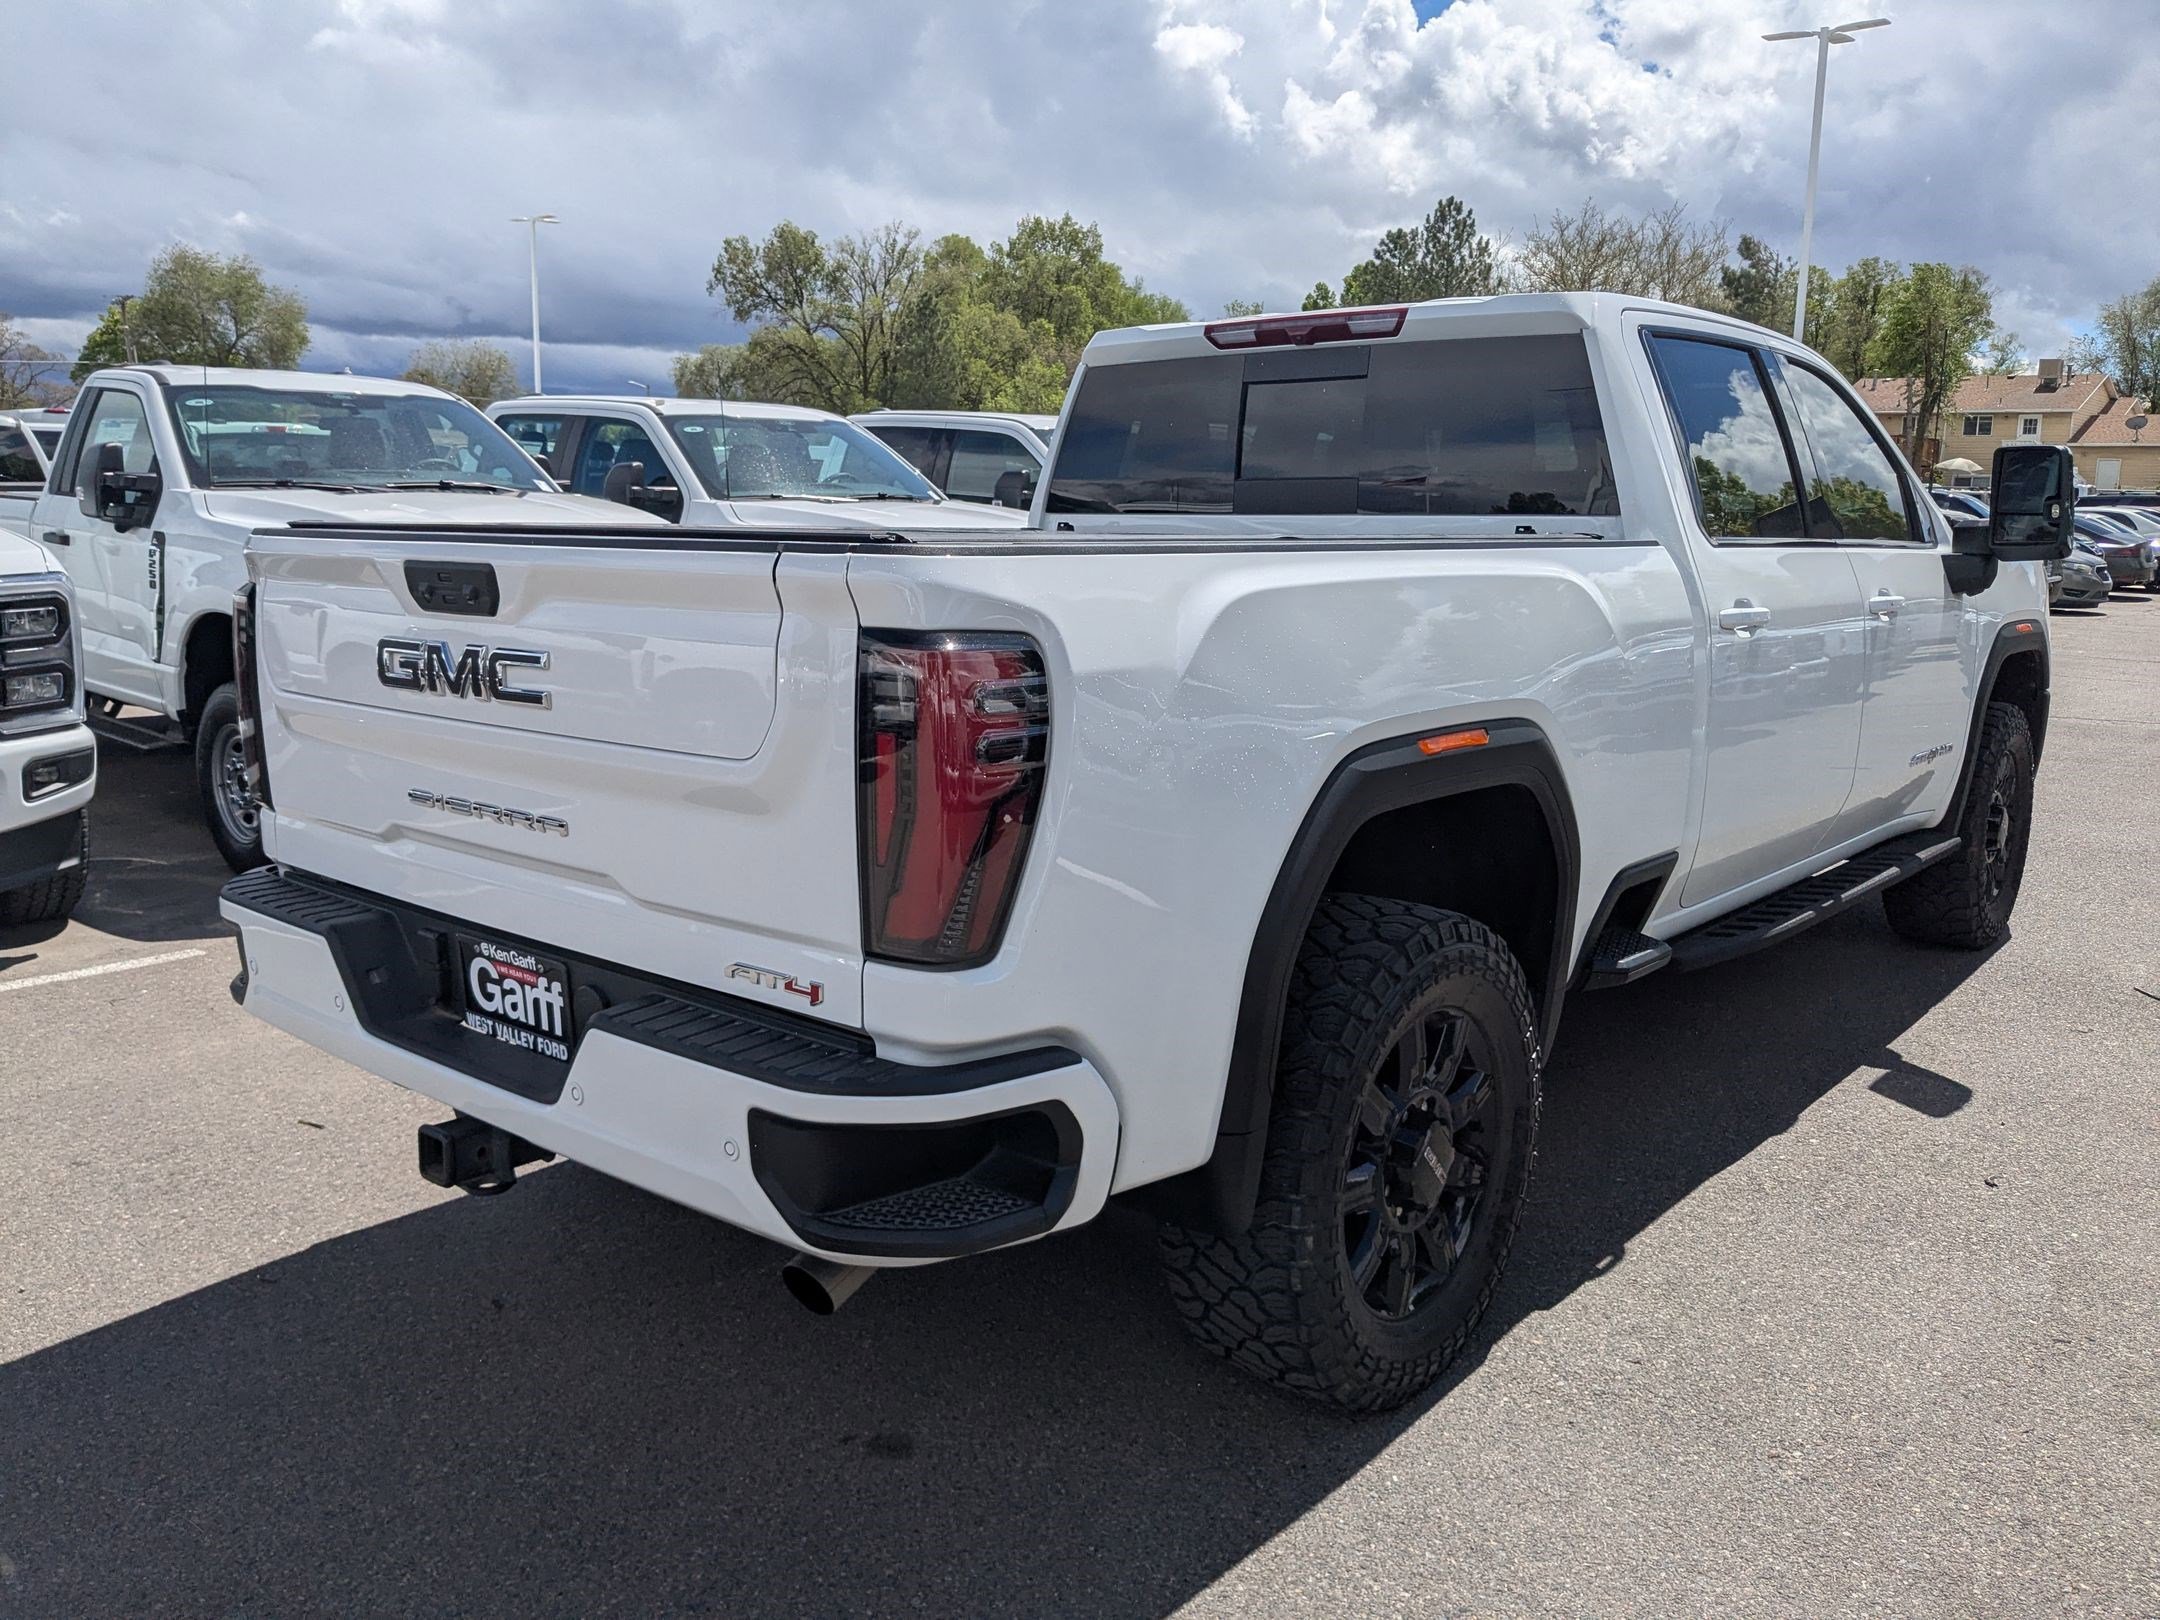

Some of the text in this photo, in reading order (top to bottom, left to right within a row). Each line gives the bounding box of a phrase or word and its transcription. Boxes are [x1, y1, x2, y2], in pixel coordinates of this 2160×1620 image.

[377, 636, 552, 711] GMC
[408, 788, 569, 837] SIERRA
[470, 957, 564, 1037] Garff
[724, 961, 824, 1006] AT4
[466, 1011, 568, 1060] WEST VALLEY FORD
